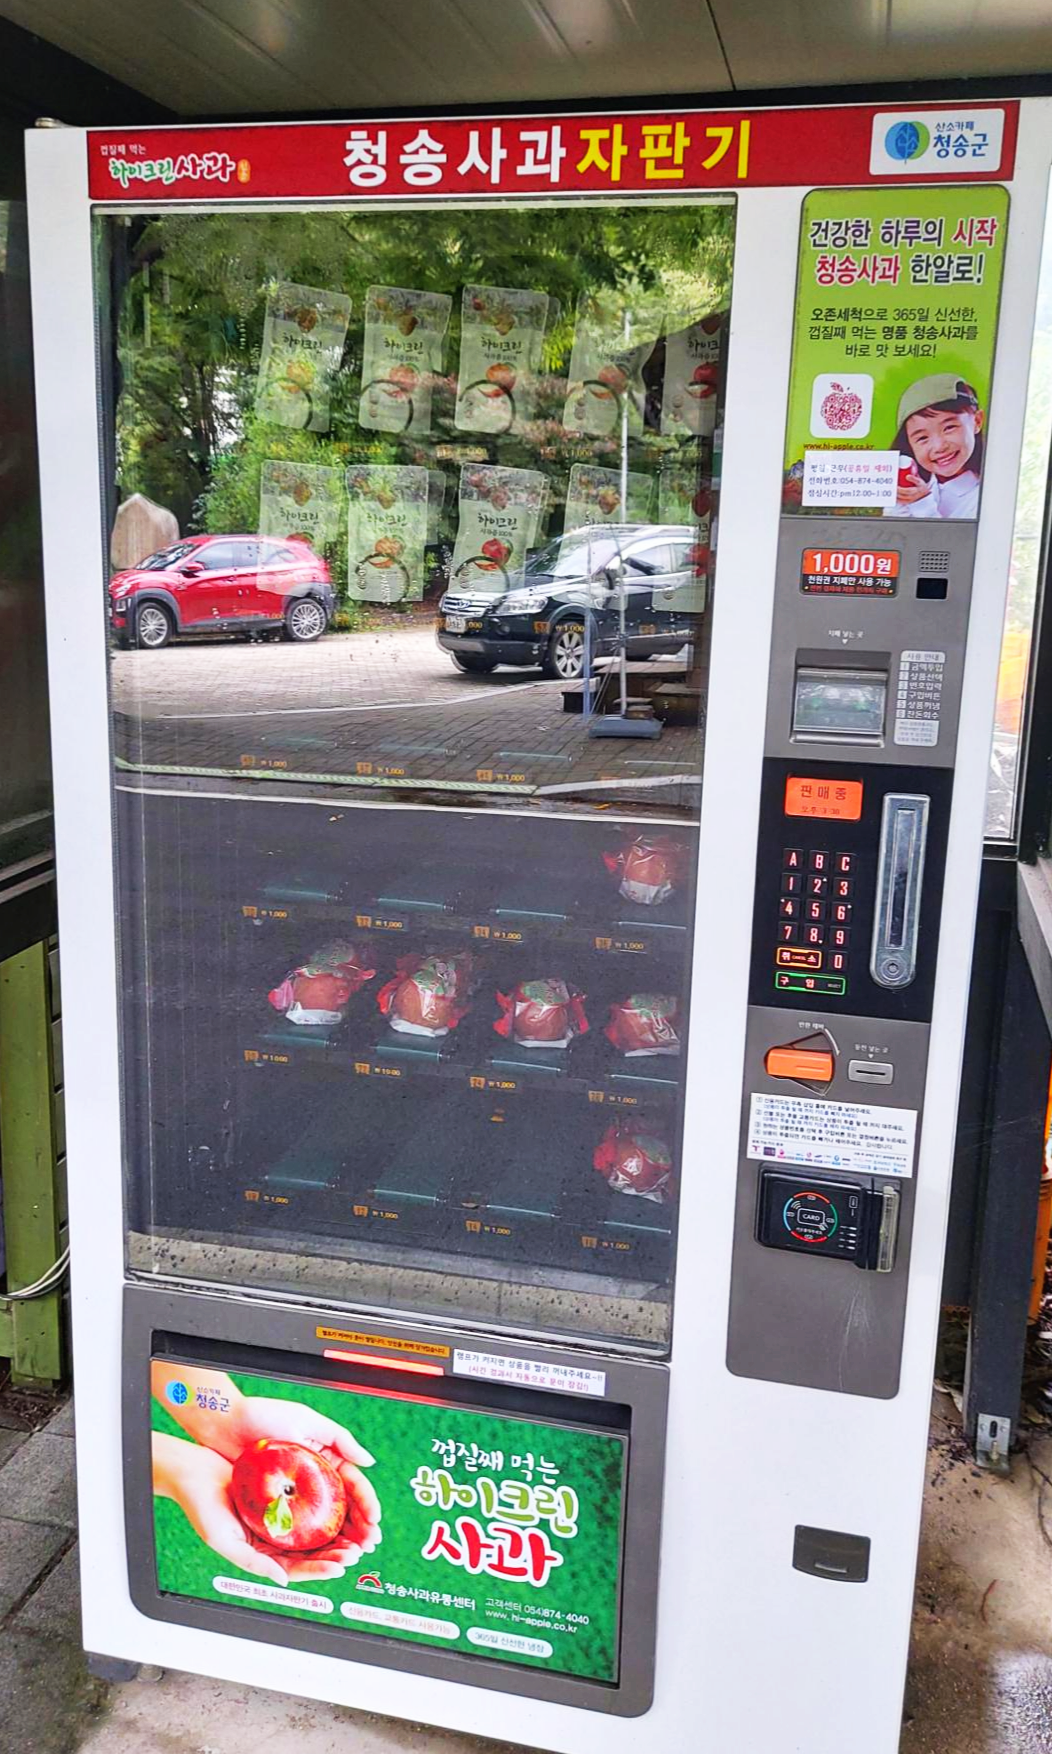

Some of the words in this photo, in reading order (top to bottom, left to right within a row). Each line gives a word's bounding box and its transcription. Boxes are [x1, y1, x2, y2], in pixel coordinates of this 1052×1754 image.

[935, 121, 974, 132] 산소카페
[129, 144, 146, 155] 먹는
[932, 133, 989, 158] 청송군
[810, 219, 871, 248] 건강한
[880, 218, 944, 248] 하루의
[953, 217, 998, 247] 시작
[816, 254, 900, 285] 청송사과
[911, 253, 984, 284] 한알로!
[810, 307, 888, 322] 오존세척으로
[893, 308, 930, 322] 365일
[934, 307, 978, 322] 신선한,
[808, 326, 846, 340] 껍질째
[852, 326, 877, 340] 먹는
[882, 326, 908, 340] 명품
[913, 326, 978, 340] 청송사과를
[845, 344, 872, 358] 바로
[876, 343, 889, 358] 맛
[893, 344, 936, 358] 보세요!
[478, 512, 518, 530] 하이크린
[813, 553, 892, 575] 1,000원
[808, 575, 831, 585] 천원권
[832, 576, 857, 586] 지폐만
[858, 577, 874, 586] 사용
[875, 578, 892, 587] 가능
[909, 681, 942, 691] 번호입력
[789, 852, 797, 867] A
[815, 854, 824, 869] B
[841, 857, 850, 872] C
[813, 879, 822, 894] 2
[840, 881, 848, 896] 3
[785, 901, 793, 916] 4
[811, 903, 820, 918] 5
[837, 906, 846, 921] 6
[785, 926, 793, 940] 7
[810, 928, 819, 942] 8
[835, 930, 844, 945] 9
[781, 951, 791, 961] 취
[807, 954, 817, 963] 소
[834, 954, 843, 969] 0
[802, 1213, 821, 1221] CARD
[508, 1360, 532, 1371] 상품을
[516, 1372, 546, 1384] 자동으로
[195, 1393, 231, 1413] 청송군
[431, 1438, 504, 1472] 껍질째
[511, 1452, 560, 1485] 먹는
[410, 1465, 579, 1538] 하이크린
[421, 1515, 565, 1588] 사과
[384, 1581, 476, 1611] 청송사과유통센터
[485, 1597, 522, 1613] 고객센터
